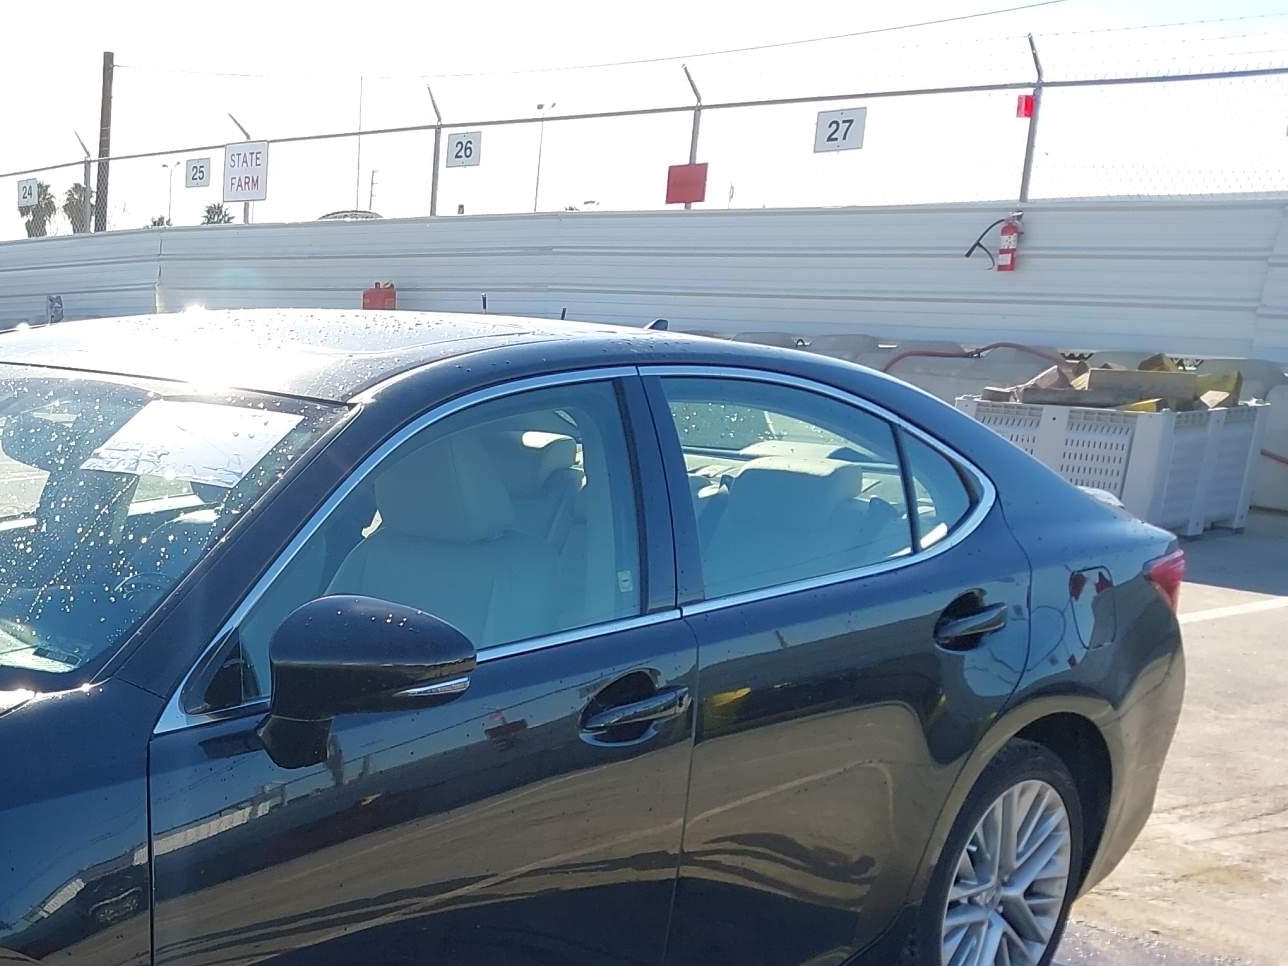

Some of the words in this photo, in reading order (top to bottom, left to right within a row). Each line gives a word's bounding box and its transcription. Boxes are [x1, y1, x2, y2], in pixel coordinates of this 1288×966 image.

[826, 119, 855, 142] 27
[454, 140, 473, 159] 26
[229, 151, 262, 168] STATE
[191, 165, 205, 181] 25
[22, 185, 33, 199] 24
[230, 175, 259, 192] FARM
